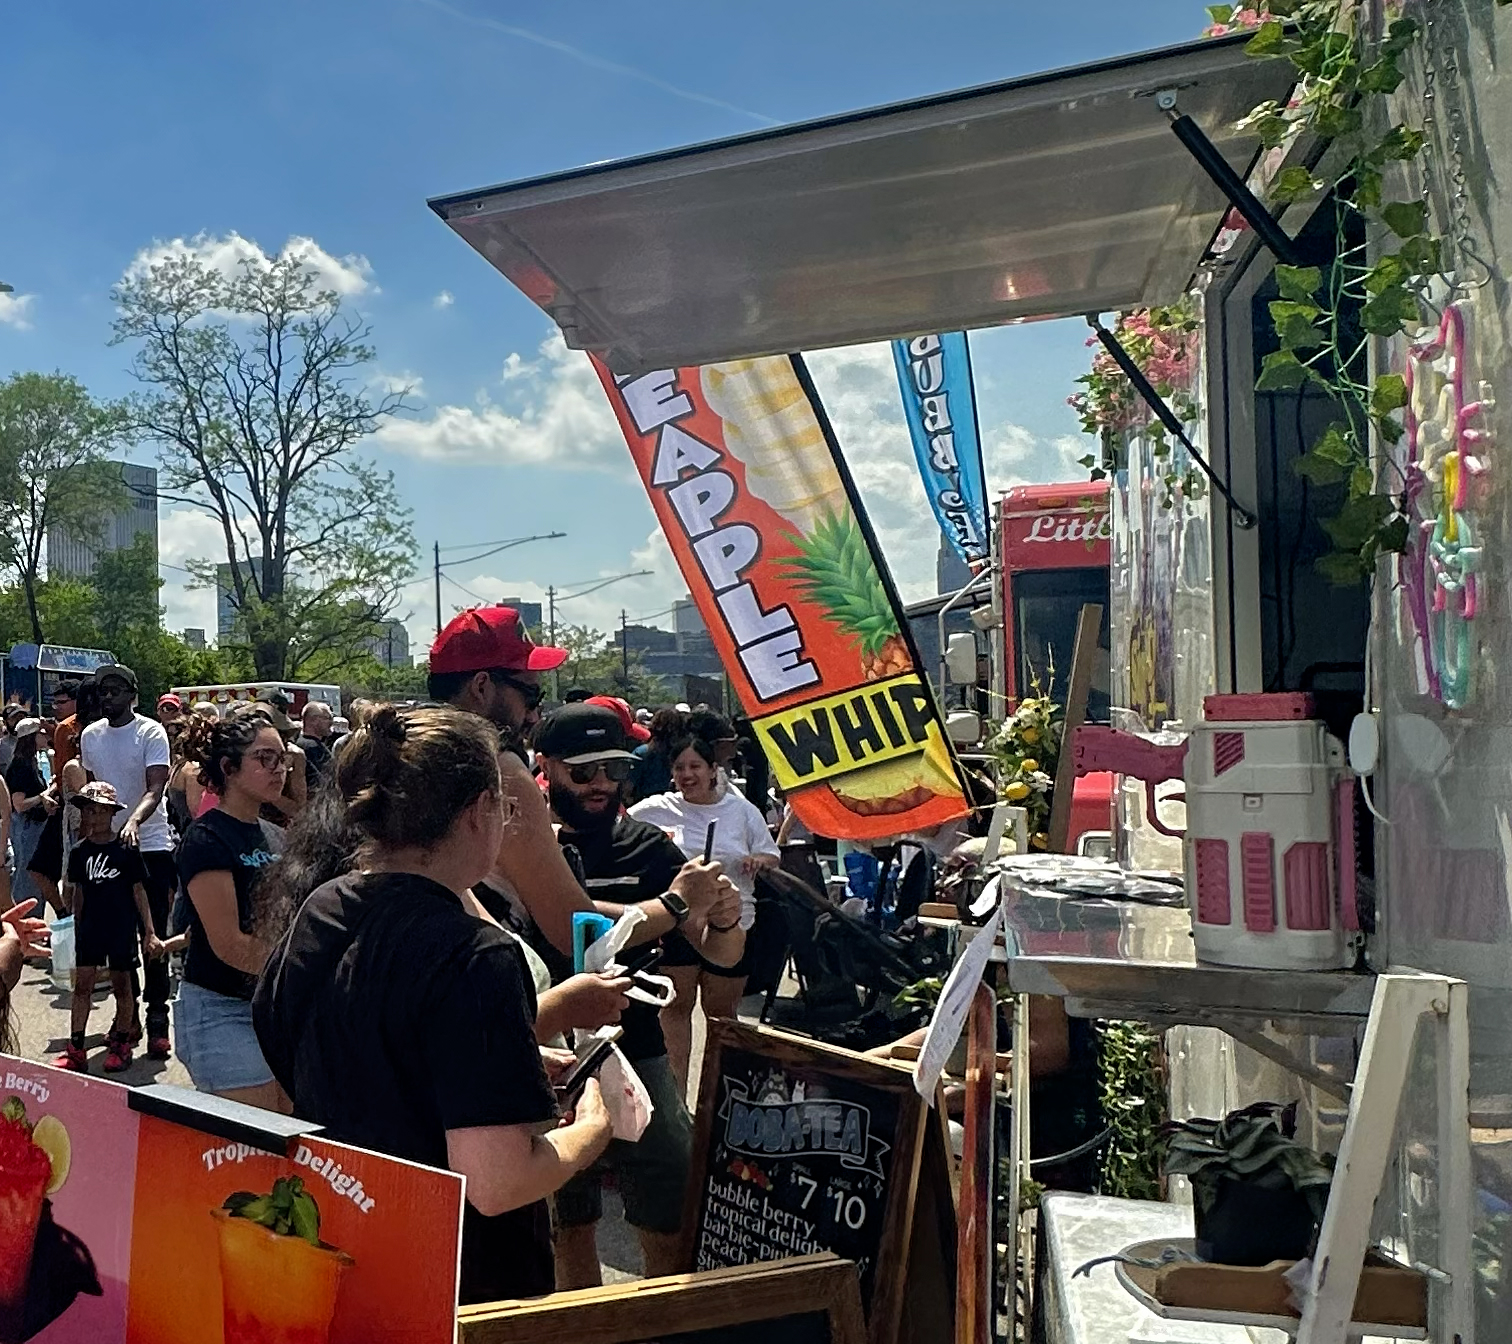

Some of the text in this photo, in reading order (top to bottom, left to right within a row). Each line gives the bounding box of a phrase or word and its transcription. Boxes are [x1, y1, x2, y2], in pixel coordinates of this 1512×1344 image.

[613, 367, 820, 703] EAPPLE
[1022, 512, 1110, 543] Littl
[766, 682, 935, 778] WHIP
[85, 852, 121, 881] Nike
[5, 1072, 50, 1103] Berry
[293, 1144, 376, 1214] Delight
[707, 1195, 766, 1236] tropical
[708, 1175, 816, 1239] bubble berry
